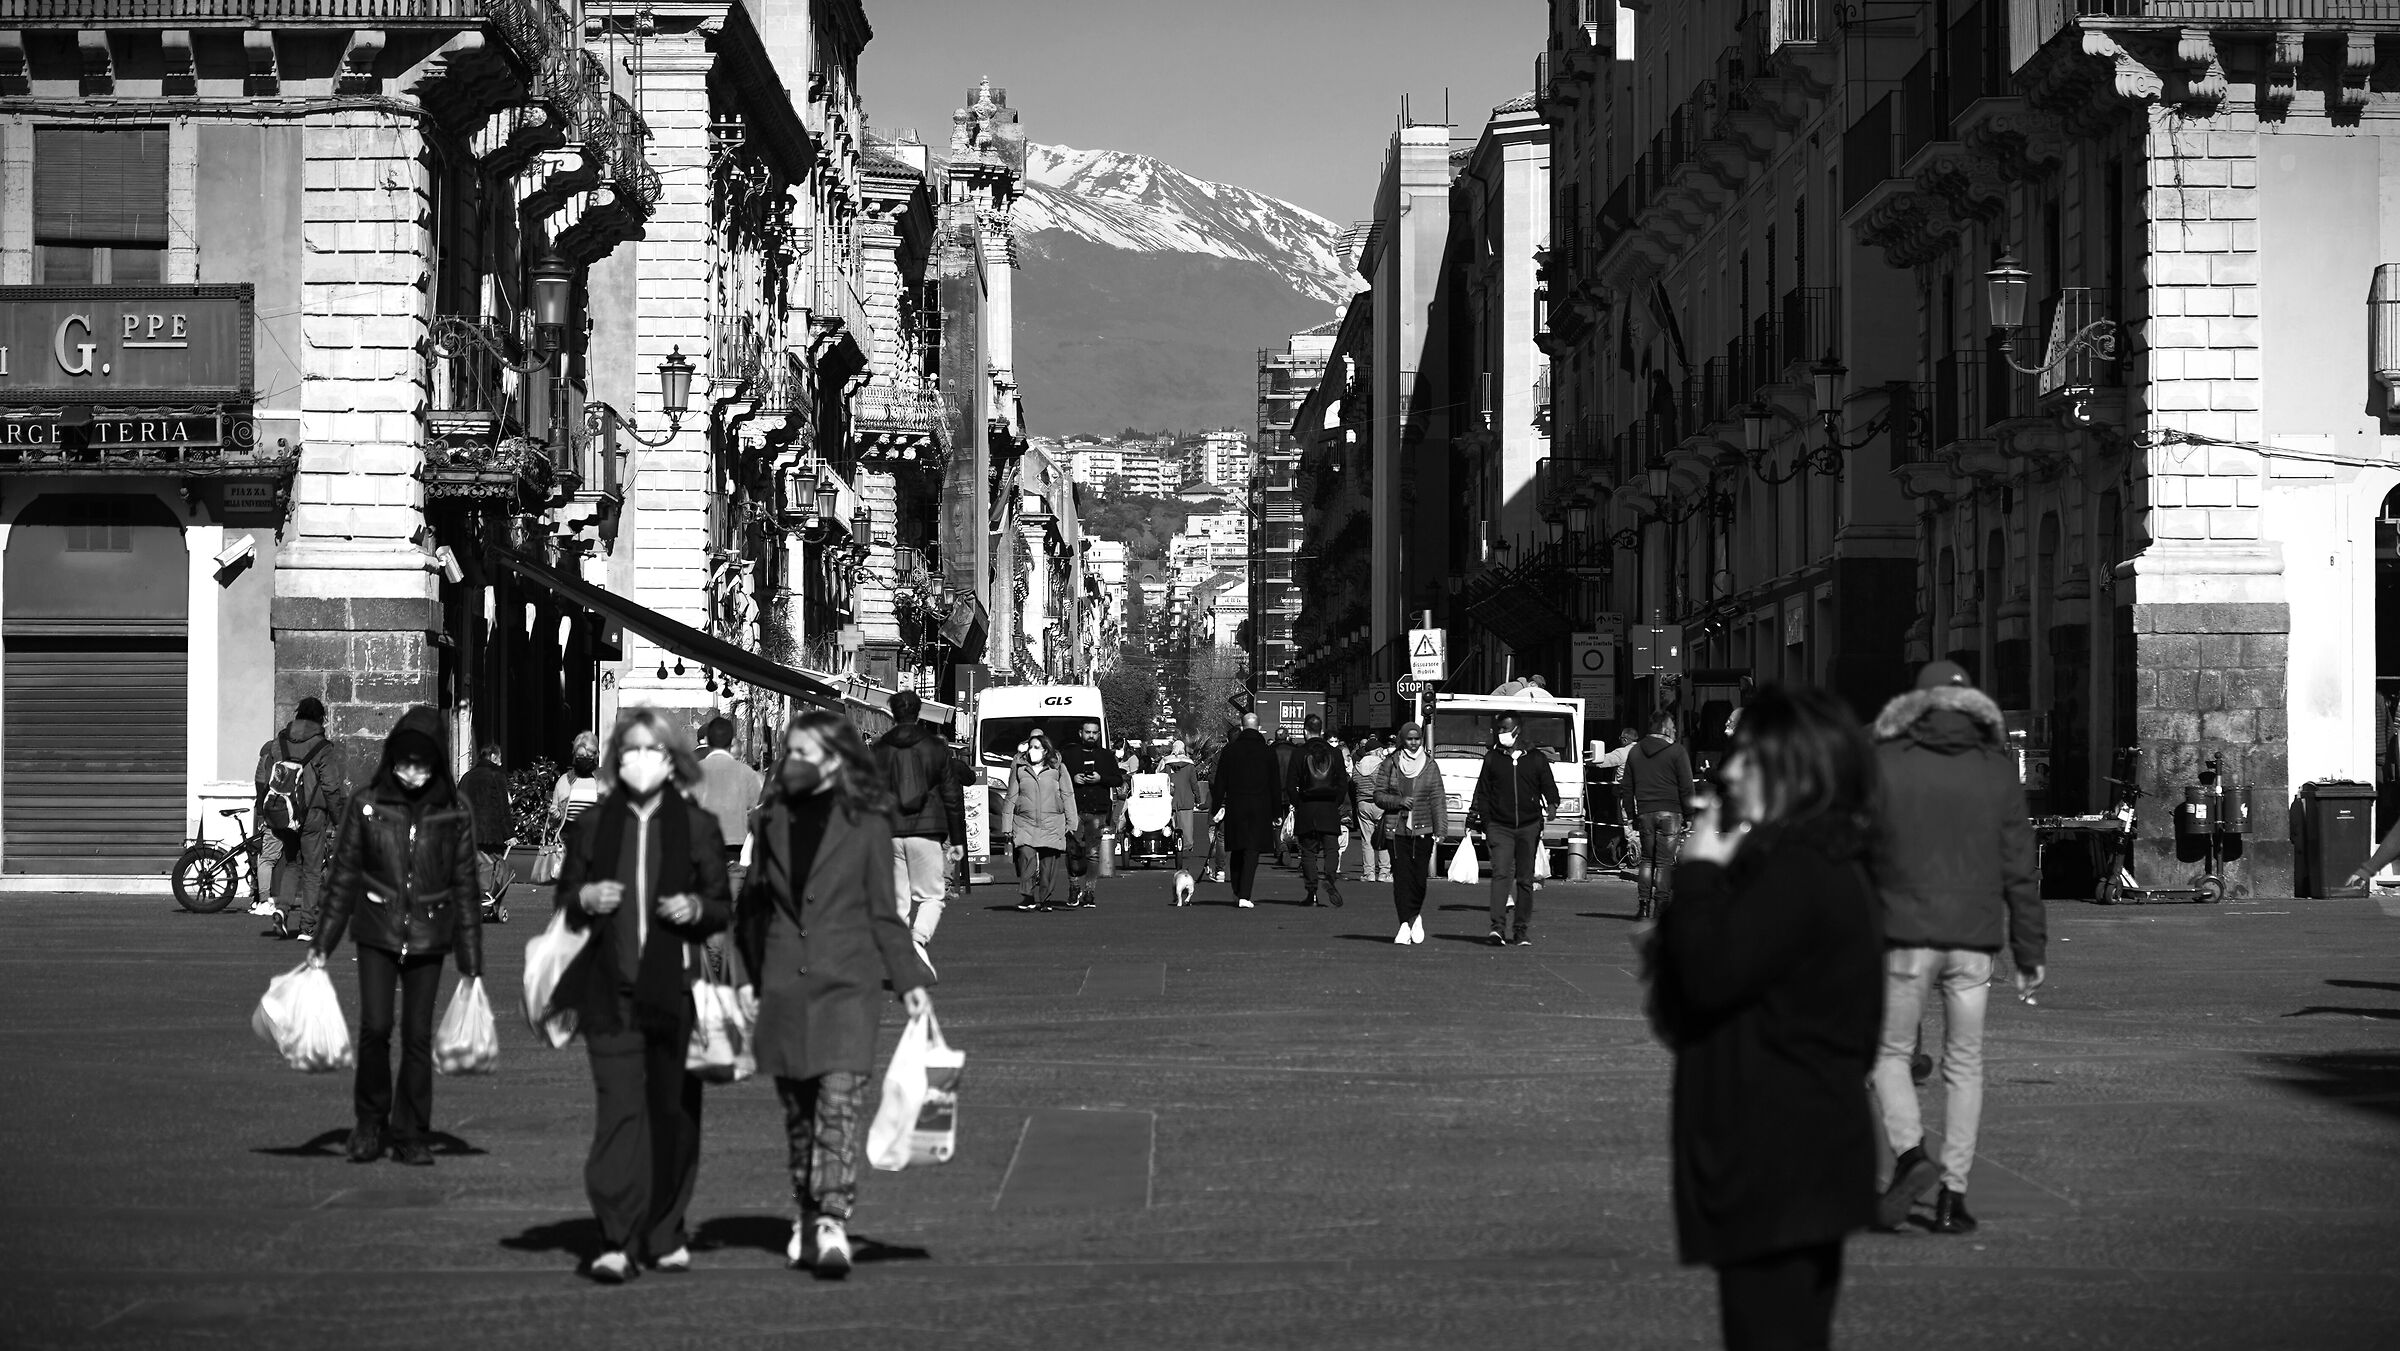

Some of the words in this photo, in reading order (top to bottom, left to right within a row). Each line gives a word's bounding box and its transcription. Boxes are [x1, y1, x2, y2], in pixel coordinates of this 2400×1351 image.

[231, 487, 266, 497] PIAZZA
[1399, 682, 1422, 693] STOP
[1044, 696, 1073, 706] GLS
[1281, 705, 1304, 719] BRT
